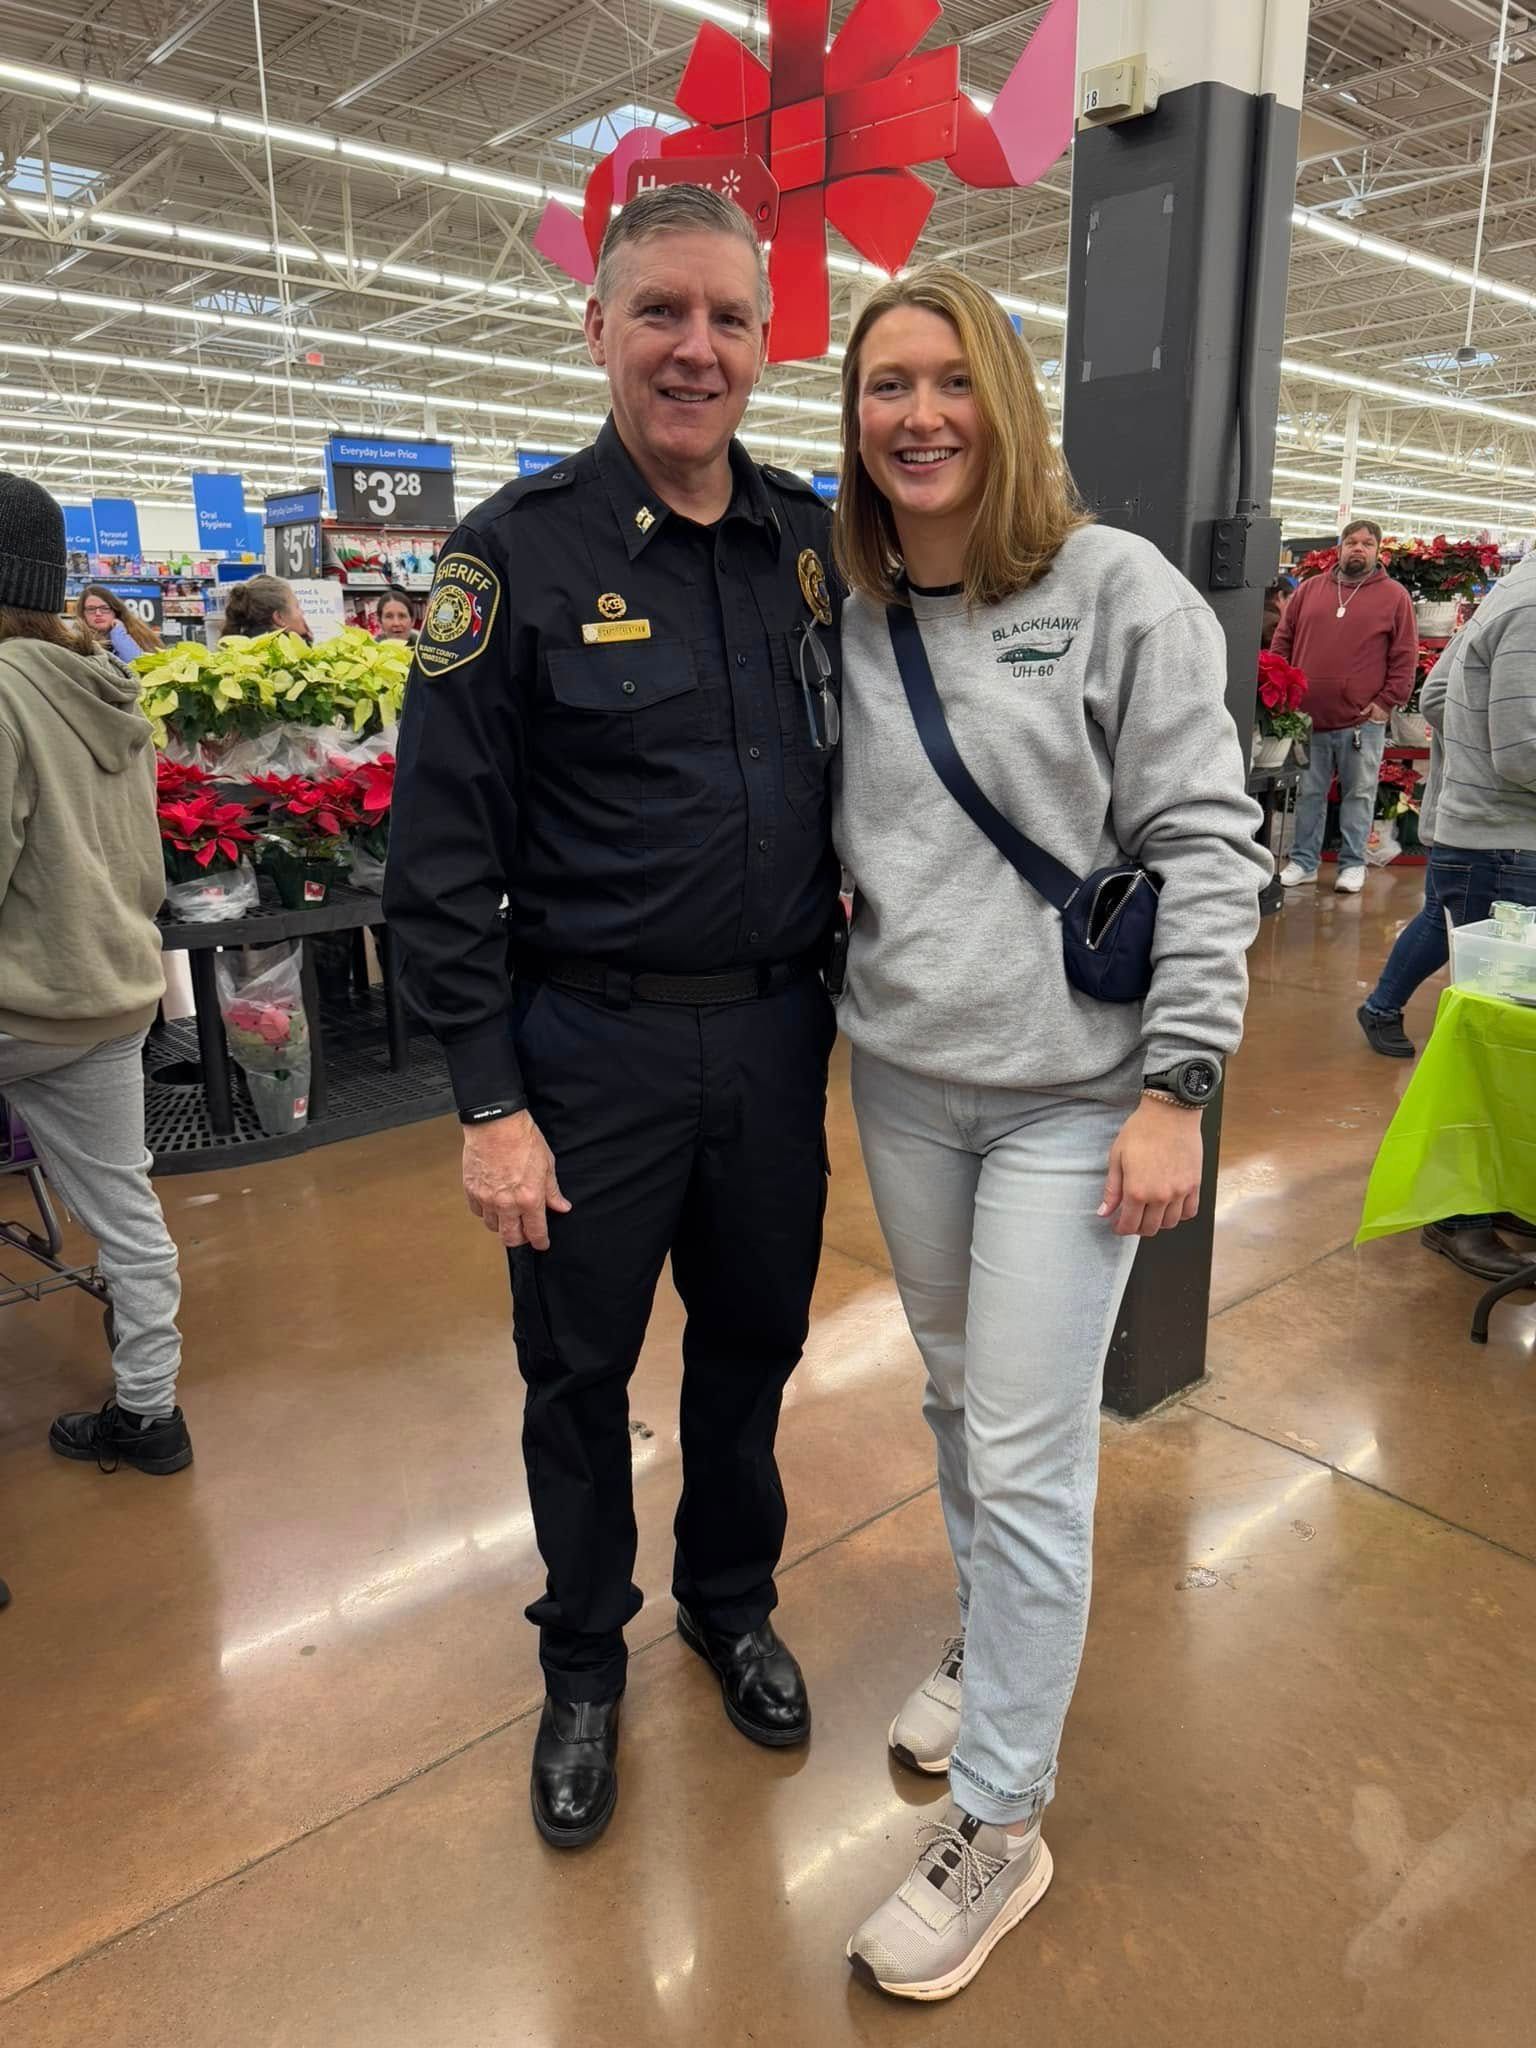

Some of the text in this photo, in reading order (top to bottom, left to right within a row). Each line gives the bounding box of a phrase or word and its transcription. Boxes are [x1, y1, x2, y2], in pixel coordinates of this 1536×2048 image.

[1086, 91, 1097, 109] 18
[340, 445, 418, 460] Everyday Low Price
[200, 511, 217, 520] Oral
[200, 520, 232, 530] Hygiene
[99, 530, 128, 539] Personal
[100, 538, 128, 548] Hygiene
[992, 617, 1081, 641] BLACKHAWK
[436, 648, 459, 660] COUNTY
[1012, 665, 1054, 678] UH-60
